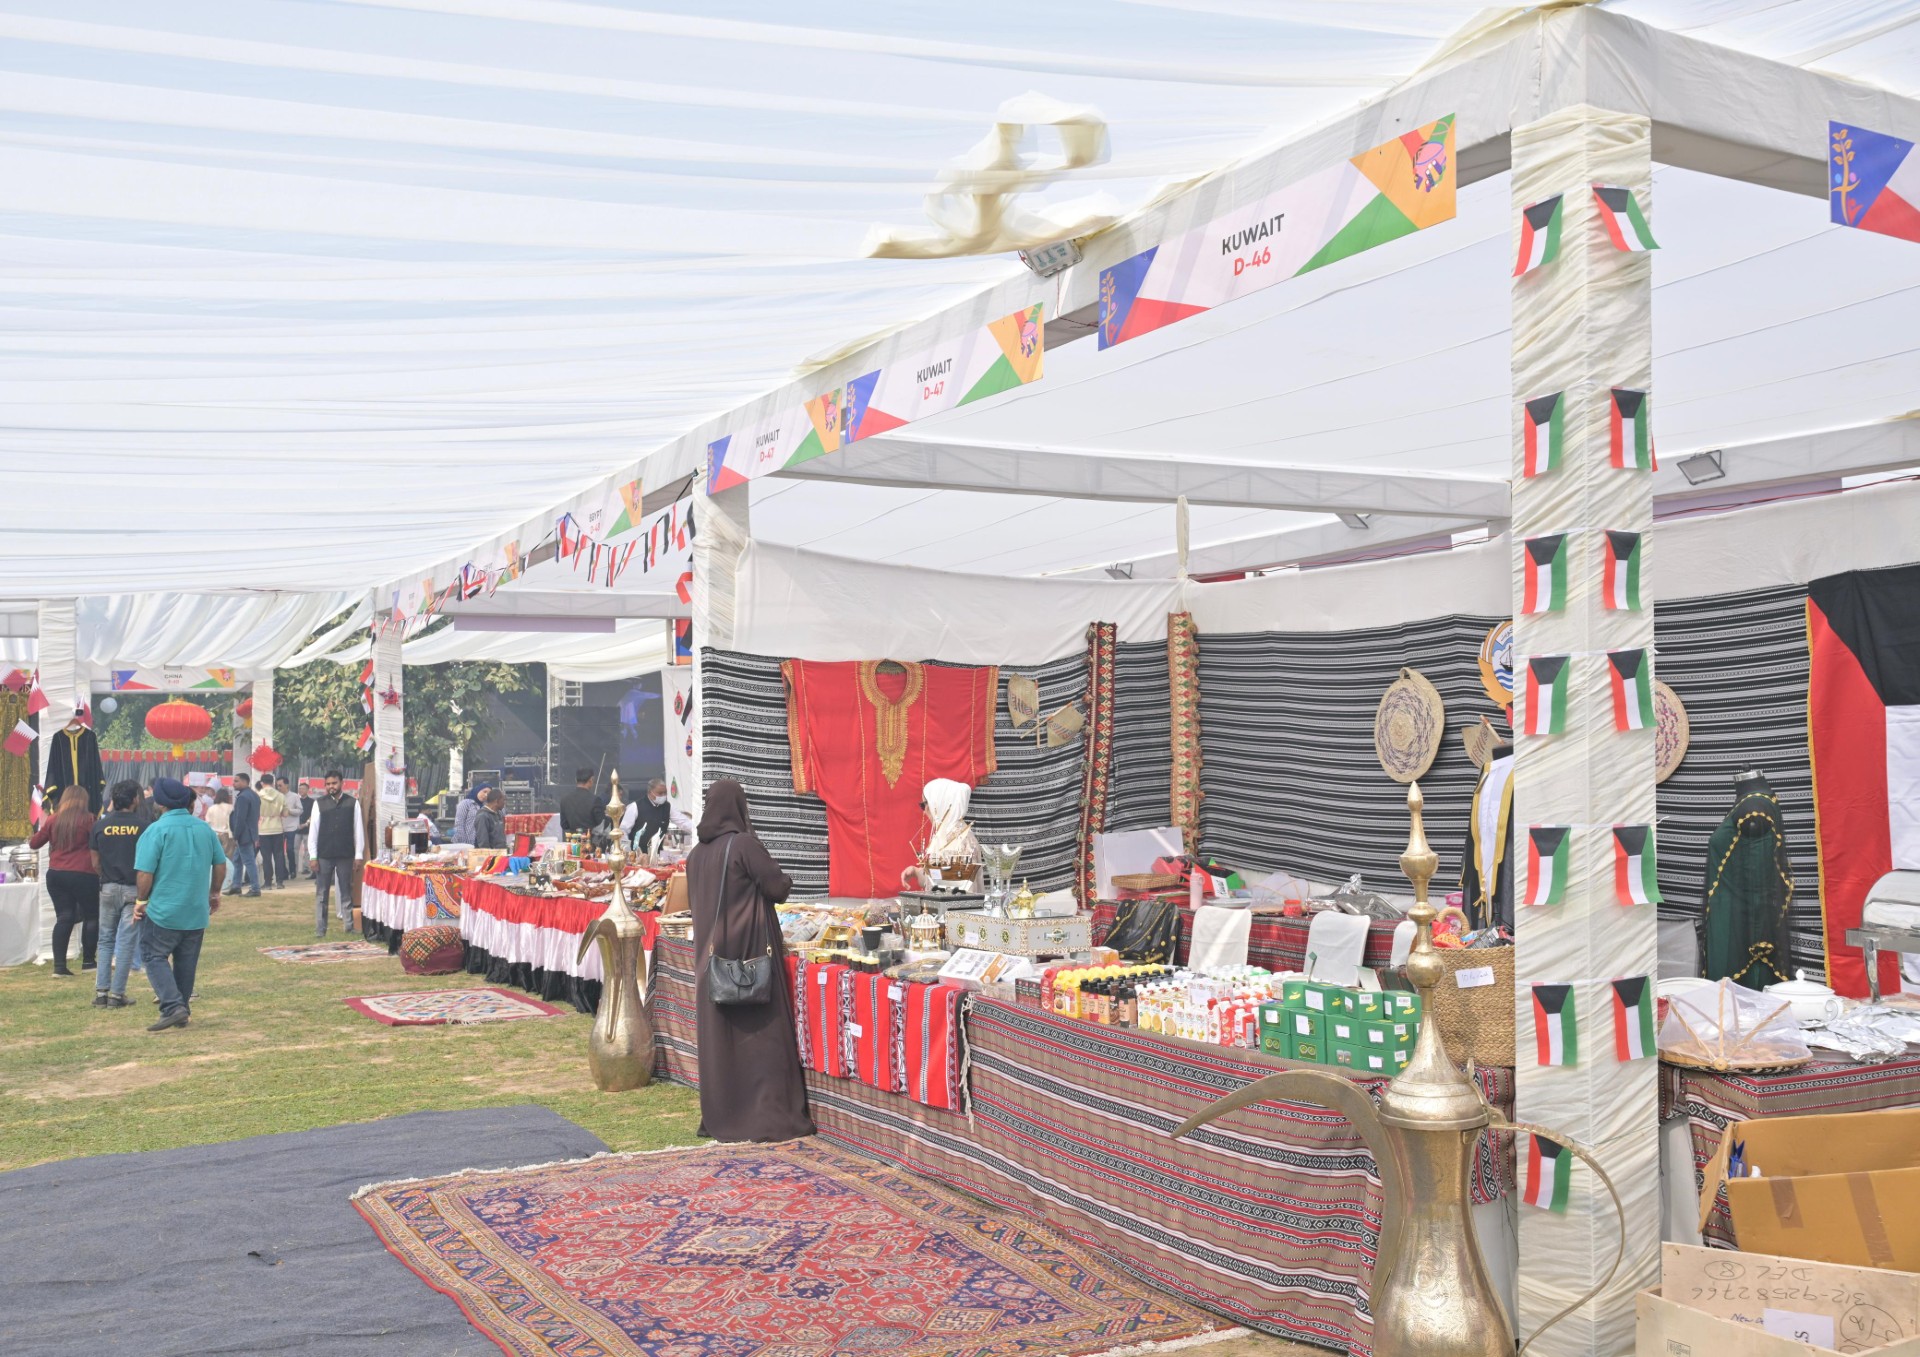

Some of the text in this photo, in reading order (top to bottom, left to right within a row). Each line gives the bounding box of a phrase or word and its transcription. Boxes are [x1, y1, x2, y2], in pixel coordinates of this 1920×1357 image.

[1222, 213, 1285, 256] KUWAIT
[1234, 246, 1271, 276] D-46
[917, 358, 952, 383] KUWAIT
[923, 381, 945, 401] D-47
[756, 429, 780, 448] KUWAIT
[760, 447, 775, 462] D-47
[103, 825, 139, 836] CREW
[1756, 1265, 1815, 1282] DEL
